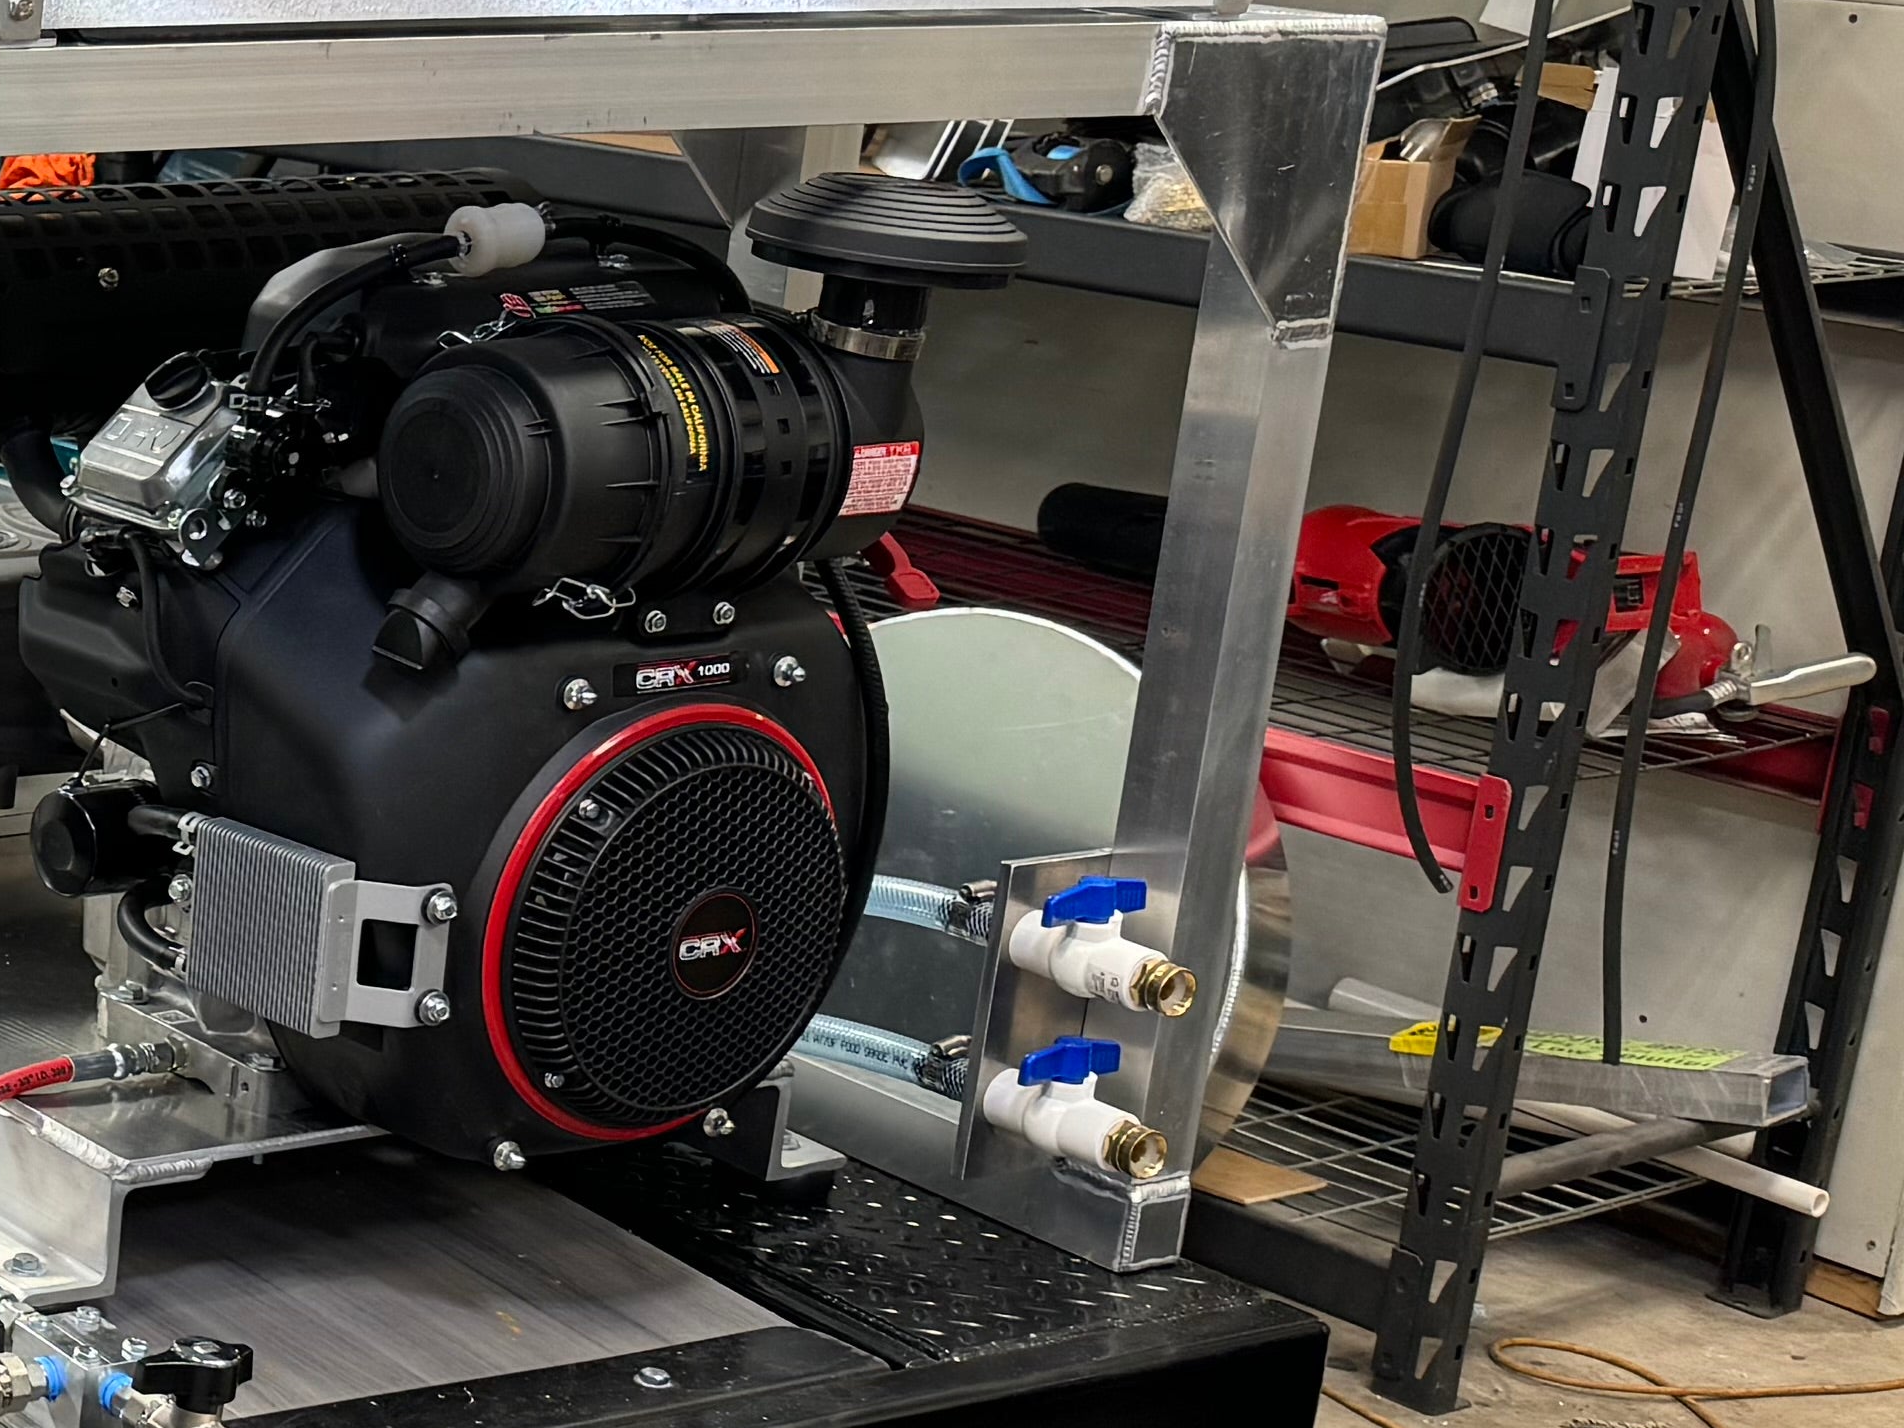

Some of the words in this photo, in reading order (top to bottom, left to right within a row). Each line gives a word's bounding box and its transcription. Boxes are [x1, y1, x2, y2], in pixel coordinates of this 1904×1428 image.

[671, 366, 691, 390] SALE
[685, 391, 697, 403] IN
[691, 404, 709, 472] CALIFORNIA
[636, 661, 699, 690] CRX
[697, 663, 731, 677] 1000
[679, 927, 747, 961] CRX
